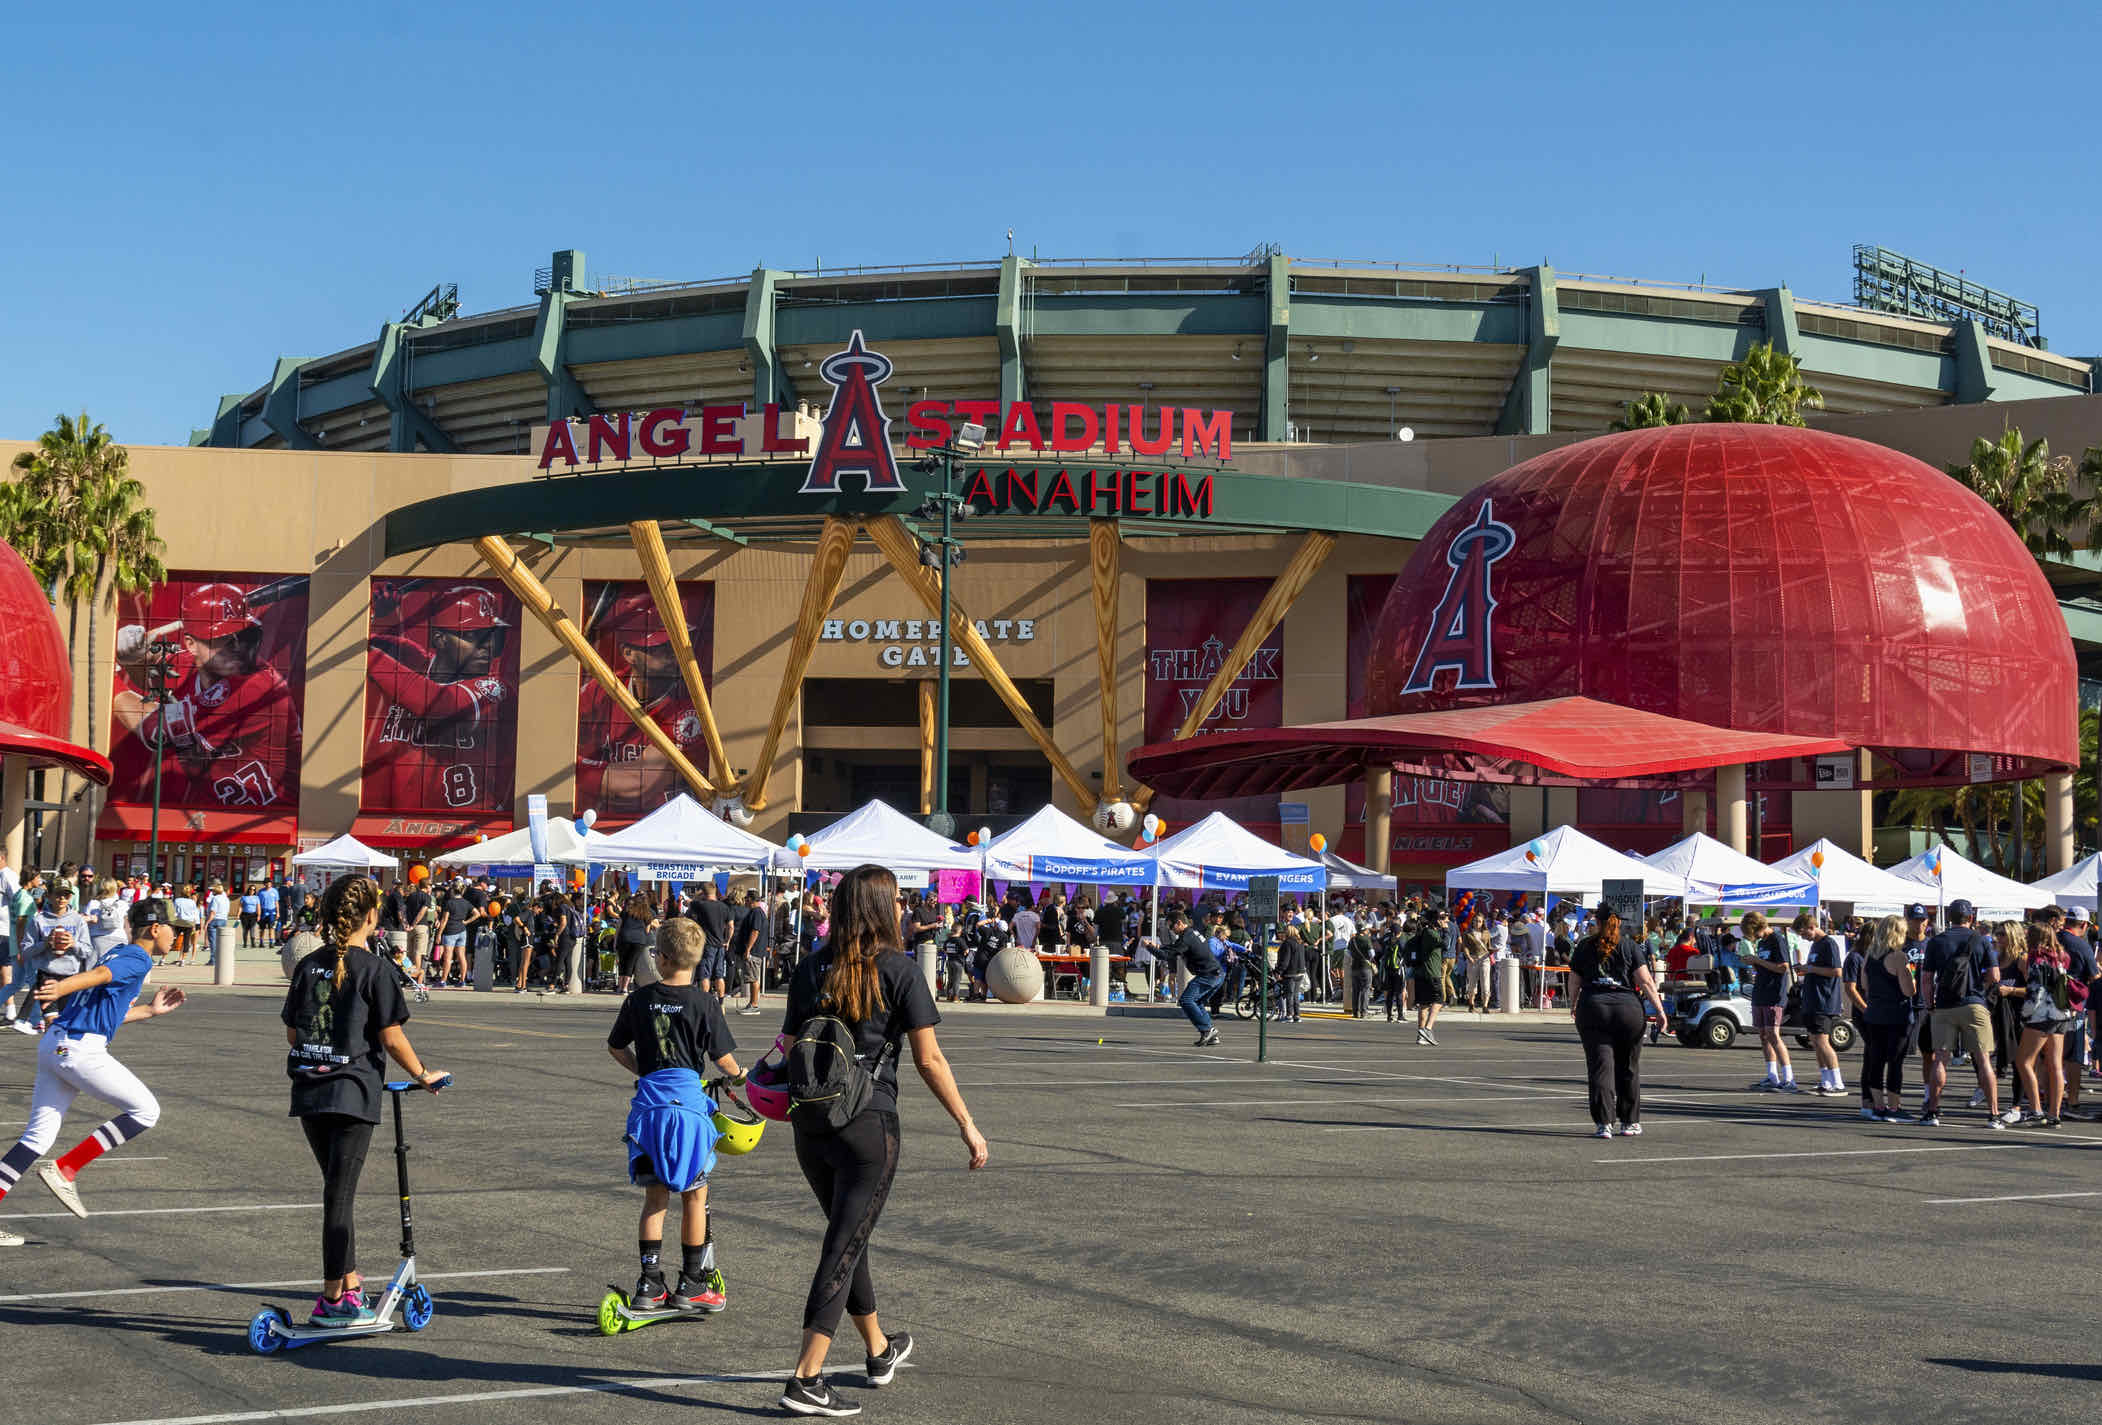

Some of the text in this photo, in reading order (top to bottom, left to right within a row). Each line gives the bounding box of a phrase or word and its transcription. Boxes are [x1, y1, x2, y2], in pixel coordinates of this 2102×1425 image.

[537, 402, 810, 469] ANGEL
[905, 400, 1233, 461] STADIUM
[965, 467, 1214, 515] ANAHEIM
[821, 619, 1035, 641] HOMEPATE
[1151, 636, 1280, 681] THAK
[213, 760, 278, 806] 27
[443, 763, 477, 807] 8
[148, 843, 250, 854] ICKETS
[647, 863, 705, 872] SEBASTIAN'S
[656, 872, 695, 880] BRIGADE
[1045, 865, 1145, 877] POPOFF'S PIRATES
